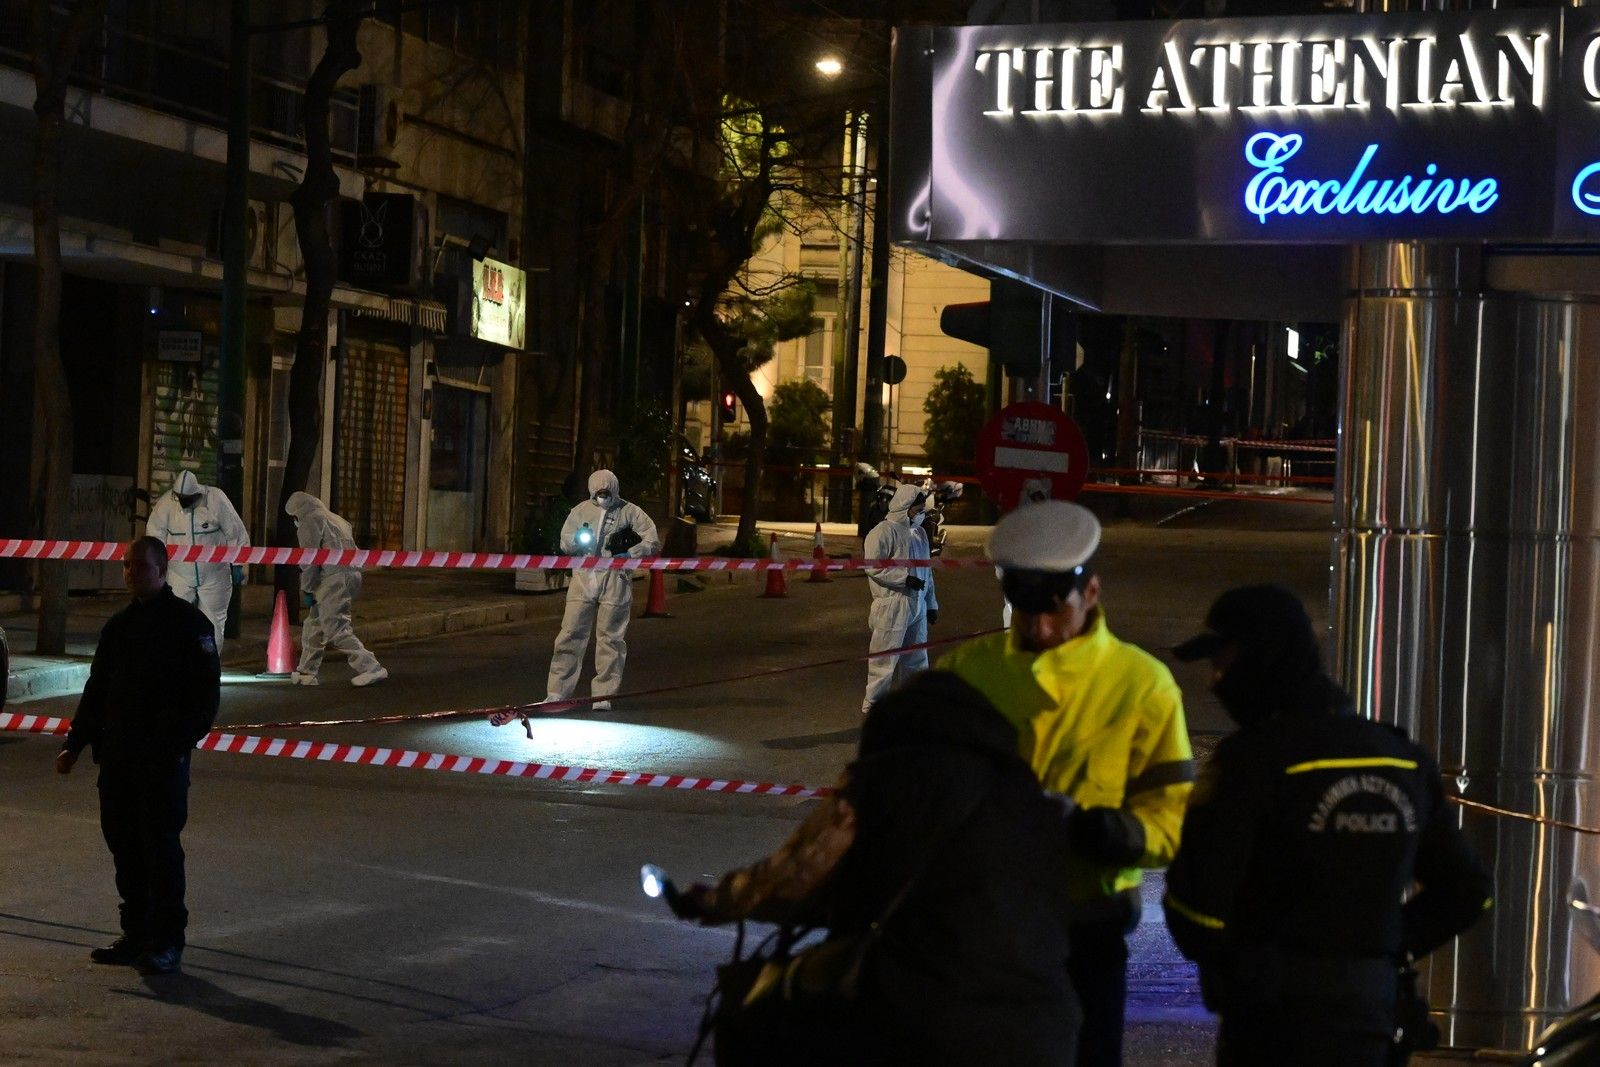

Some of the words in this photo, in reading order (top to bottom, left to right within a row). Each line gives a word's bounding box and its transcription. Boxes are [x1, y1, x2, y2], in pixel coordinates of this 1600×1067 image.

[974, 43, 1124, 117] THE
[1140, 31, 1549, 115] ATHENIAN
[1243, 131, 1499, 224] Exclusive
